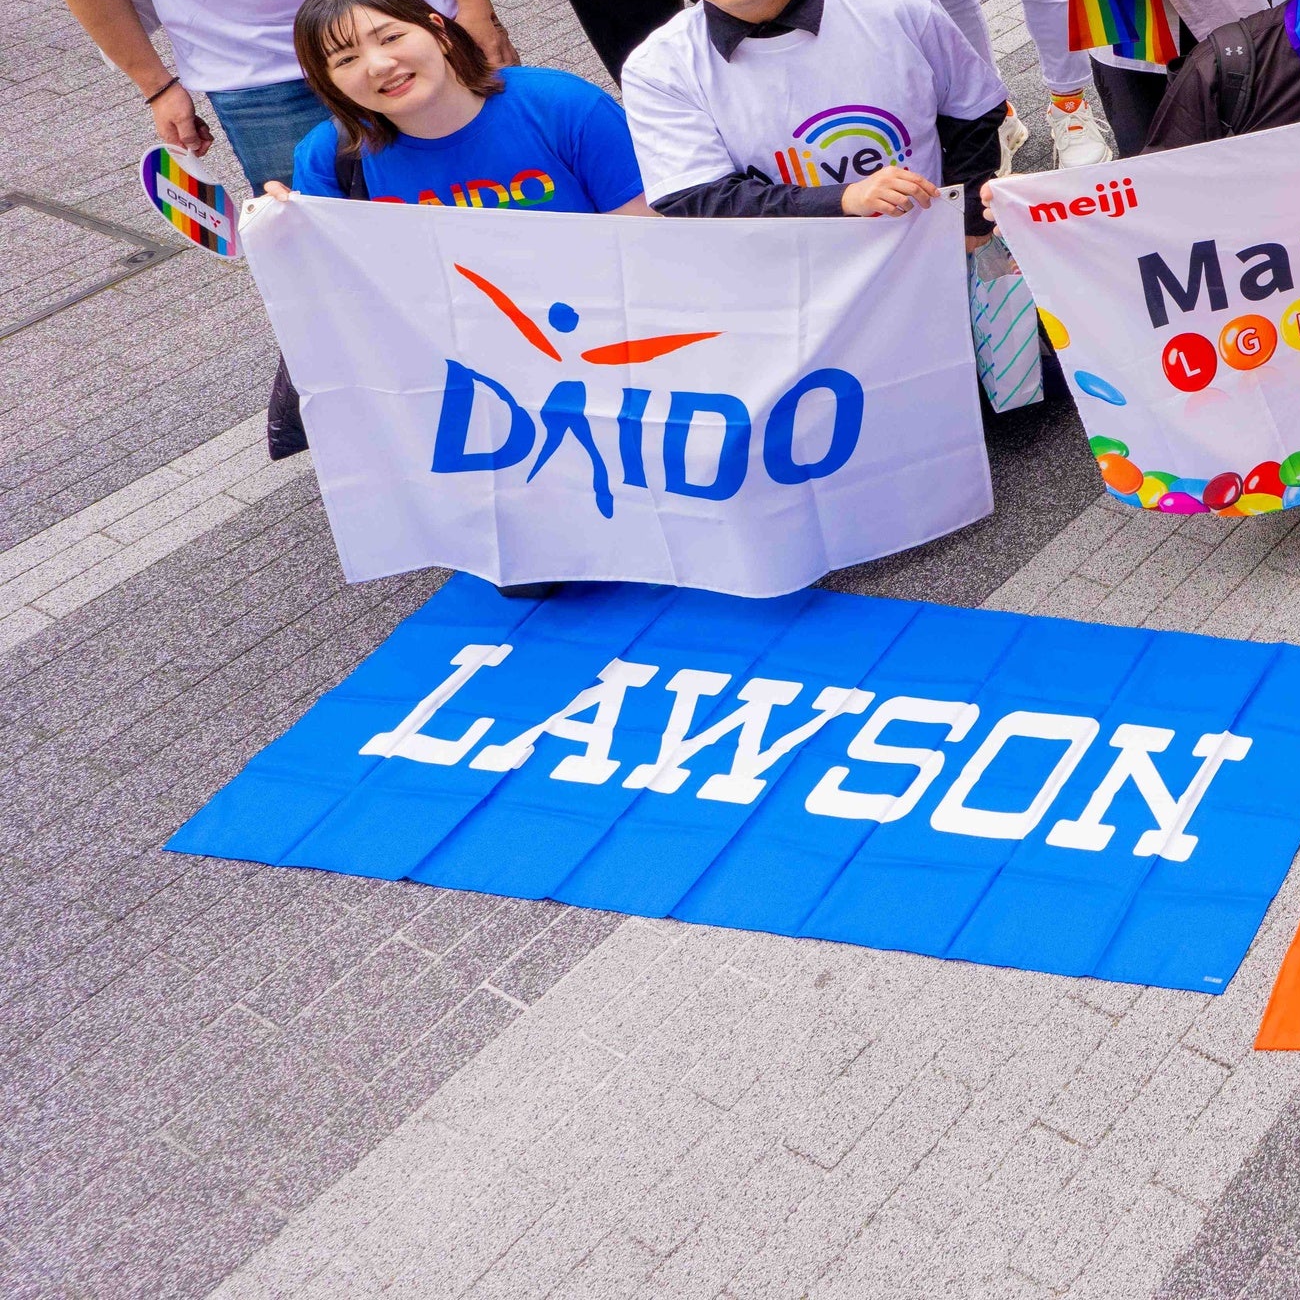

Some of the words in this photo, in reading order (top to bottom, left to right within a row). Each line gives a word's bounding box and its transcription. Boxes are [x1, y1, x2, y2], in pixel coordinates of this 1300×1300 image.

[166, 188, 207, 219] FUSO
[371, 169, 555, 209] IDO
[1029, 177, 1139, 223] meiji
[430, 358, 865, 520] DAIDO
[358, 643, 1253, 863] LAWSON
